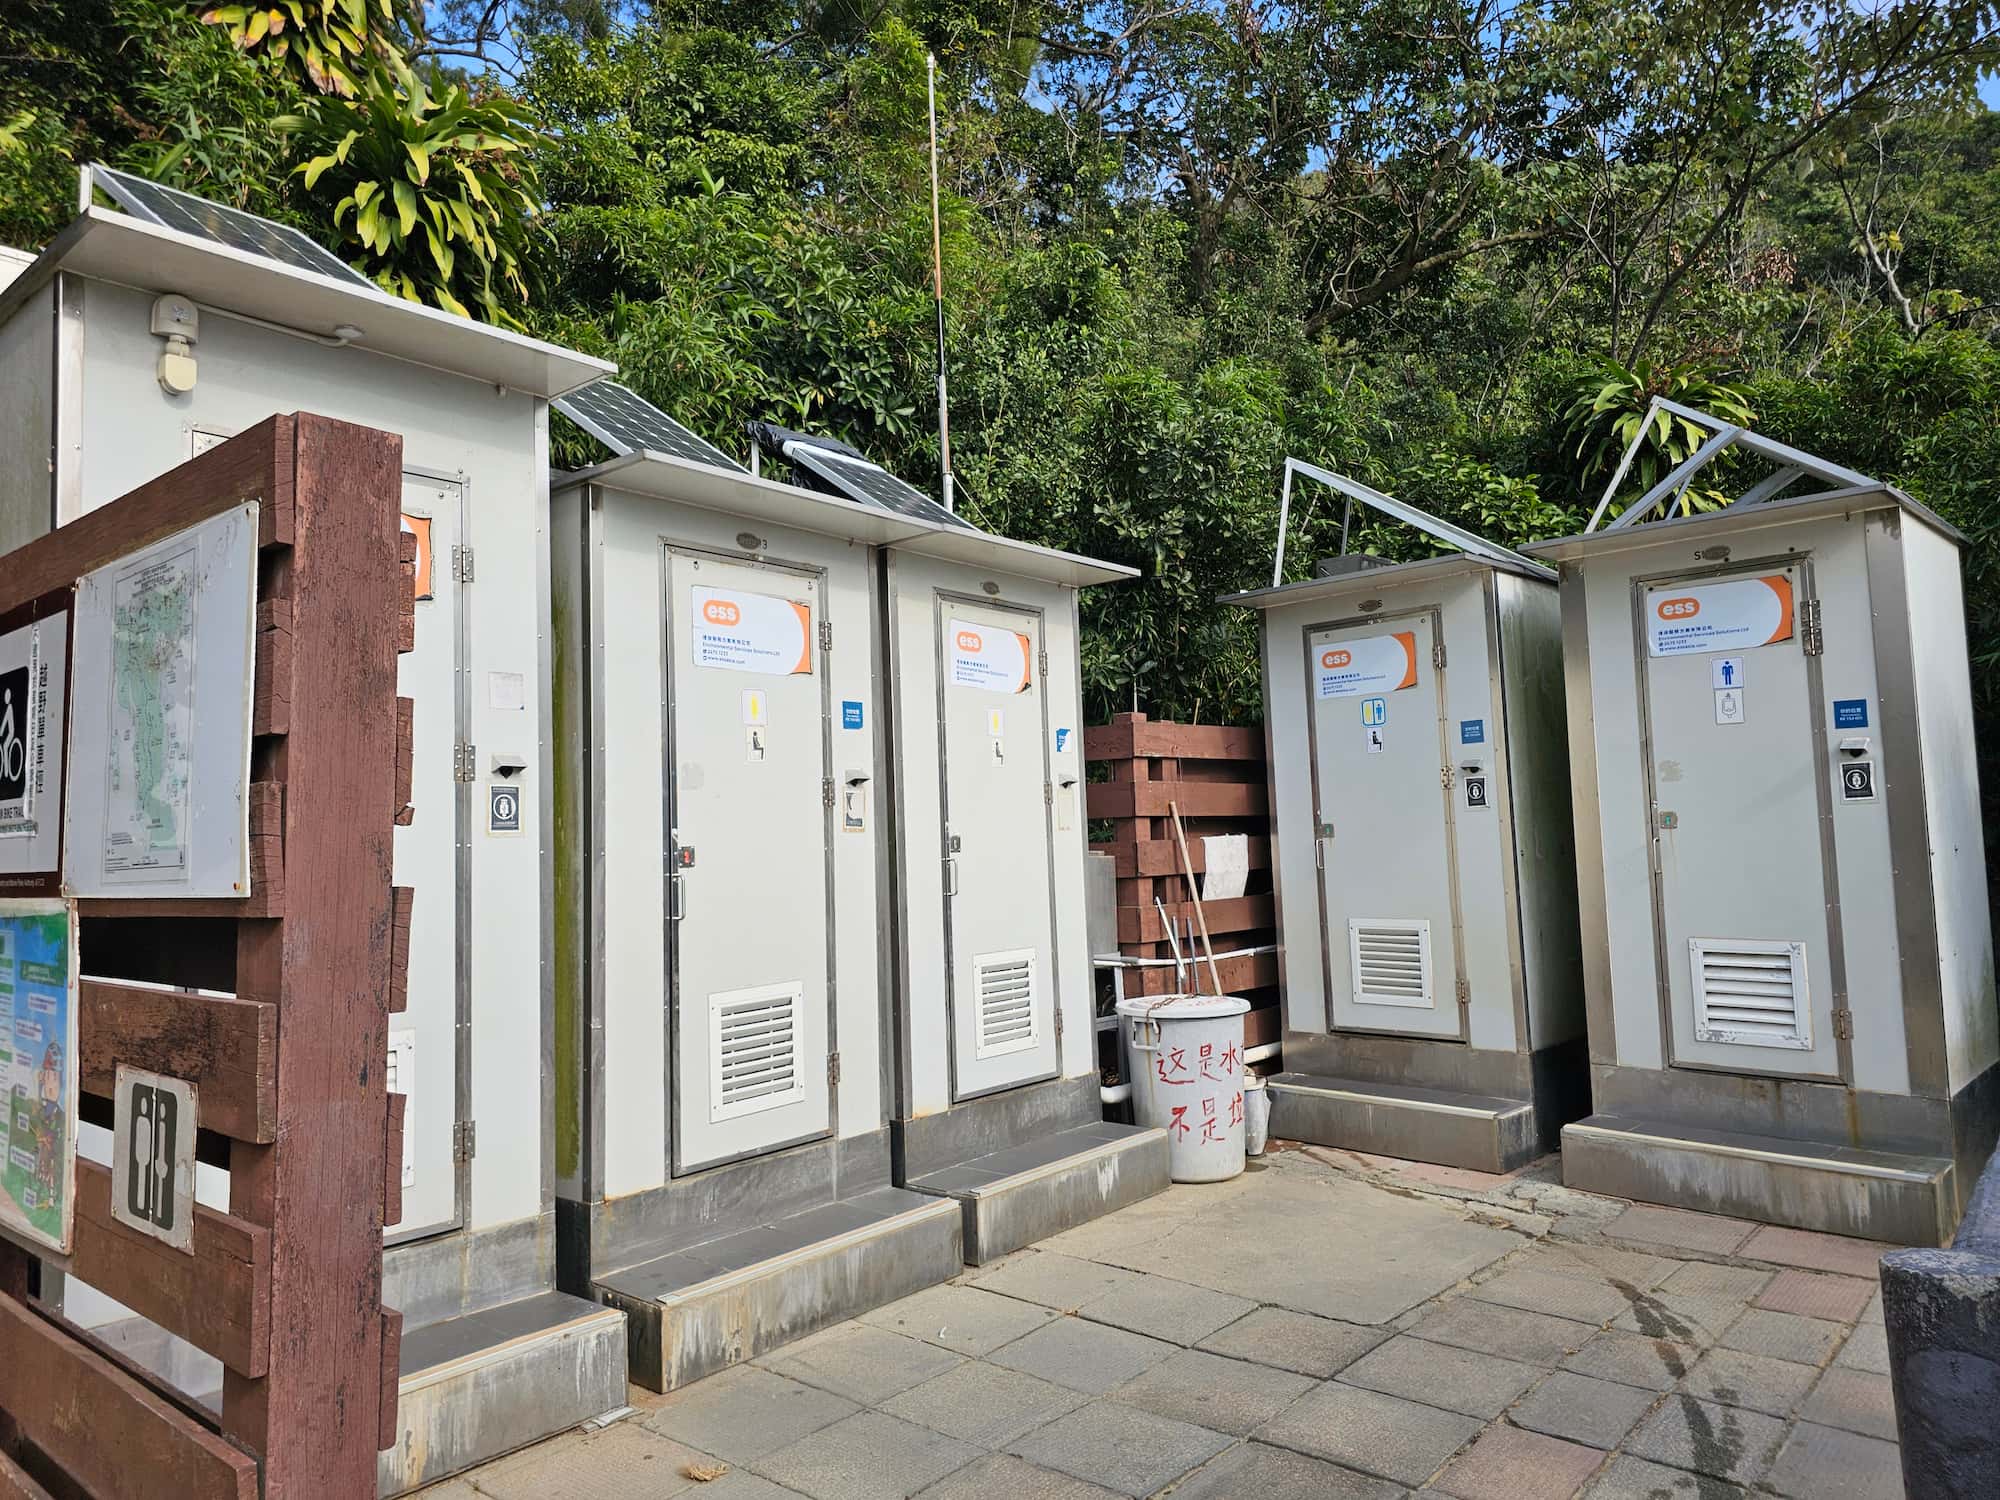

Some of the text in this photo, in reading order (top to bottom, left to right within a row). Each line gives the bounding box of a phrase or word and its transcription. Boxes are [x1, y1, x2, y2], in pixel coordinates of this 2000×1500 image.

[708, 605, 735, 621] ess
[1662, 602, 1695, 616] ess
[960, 636, 978, 647] ess
[1325, 653, 1348, 665] ess
[1156, 1040, 1244, 1085] 这是水
